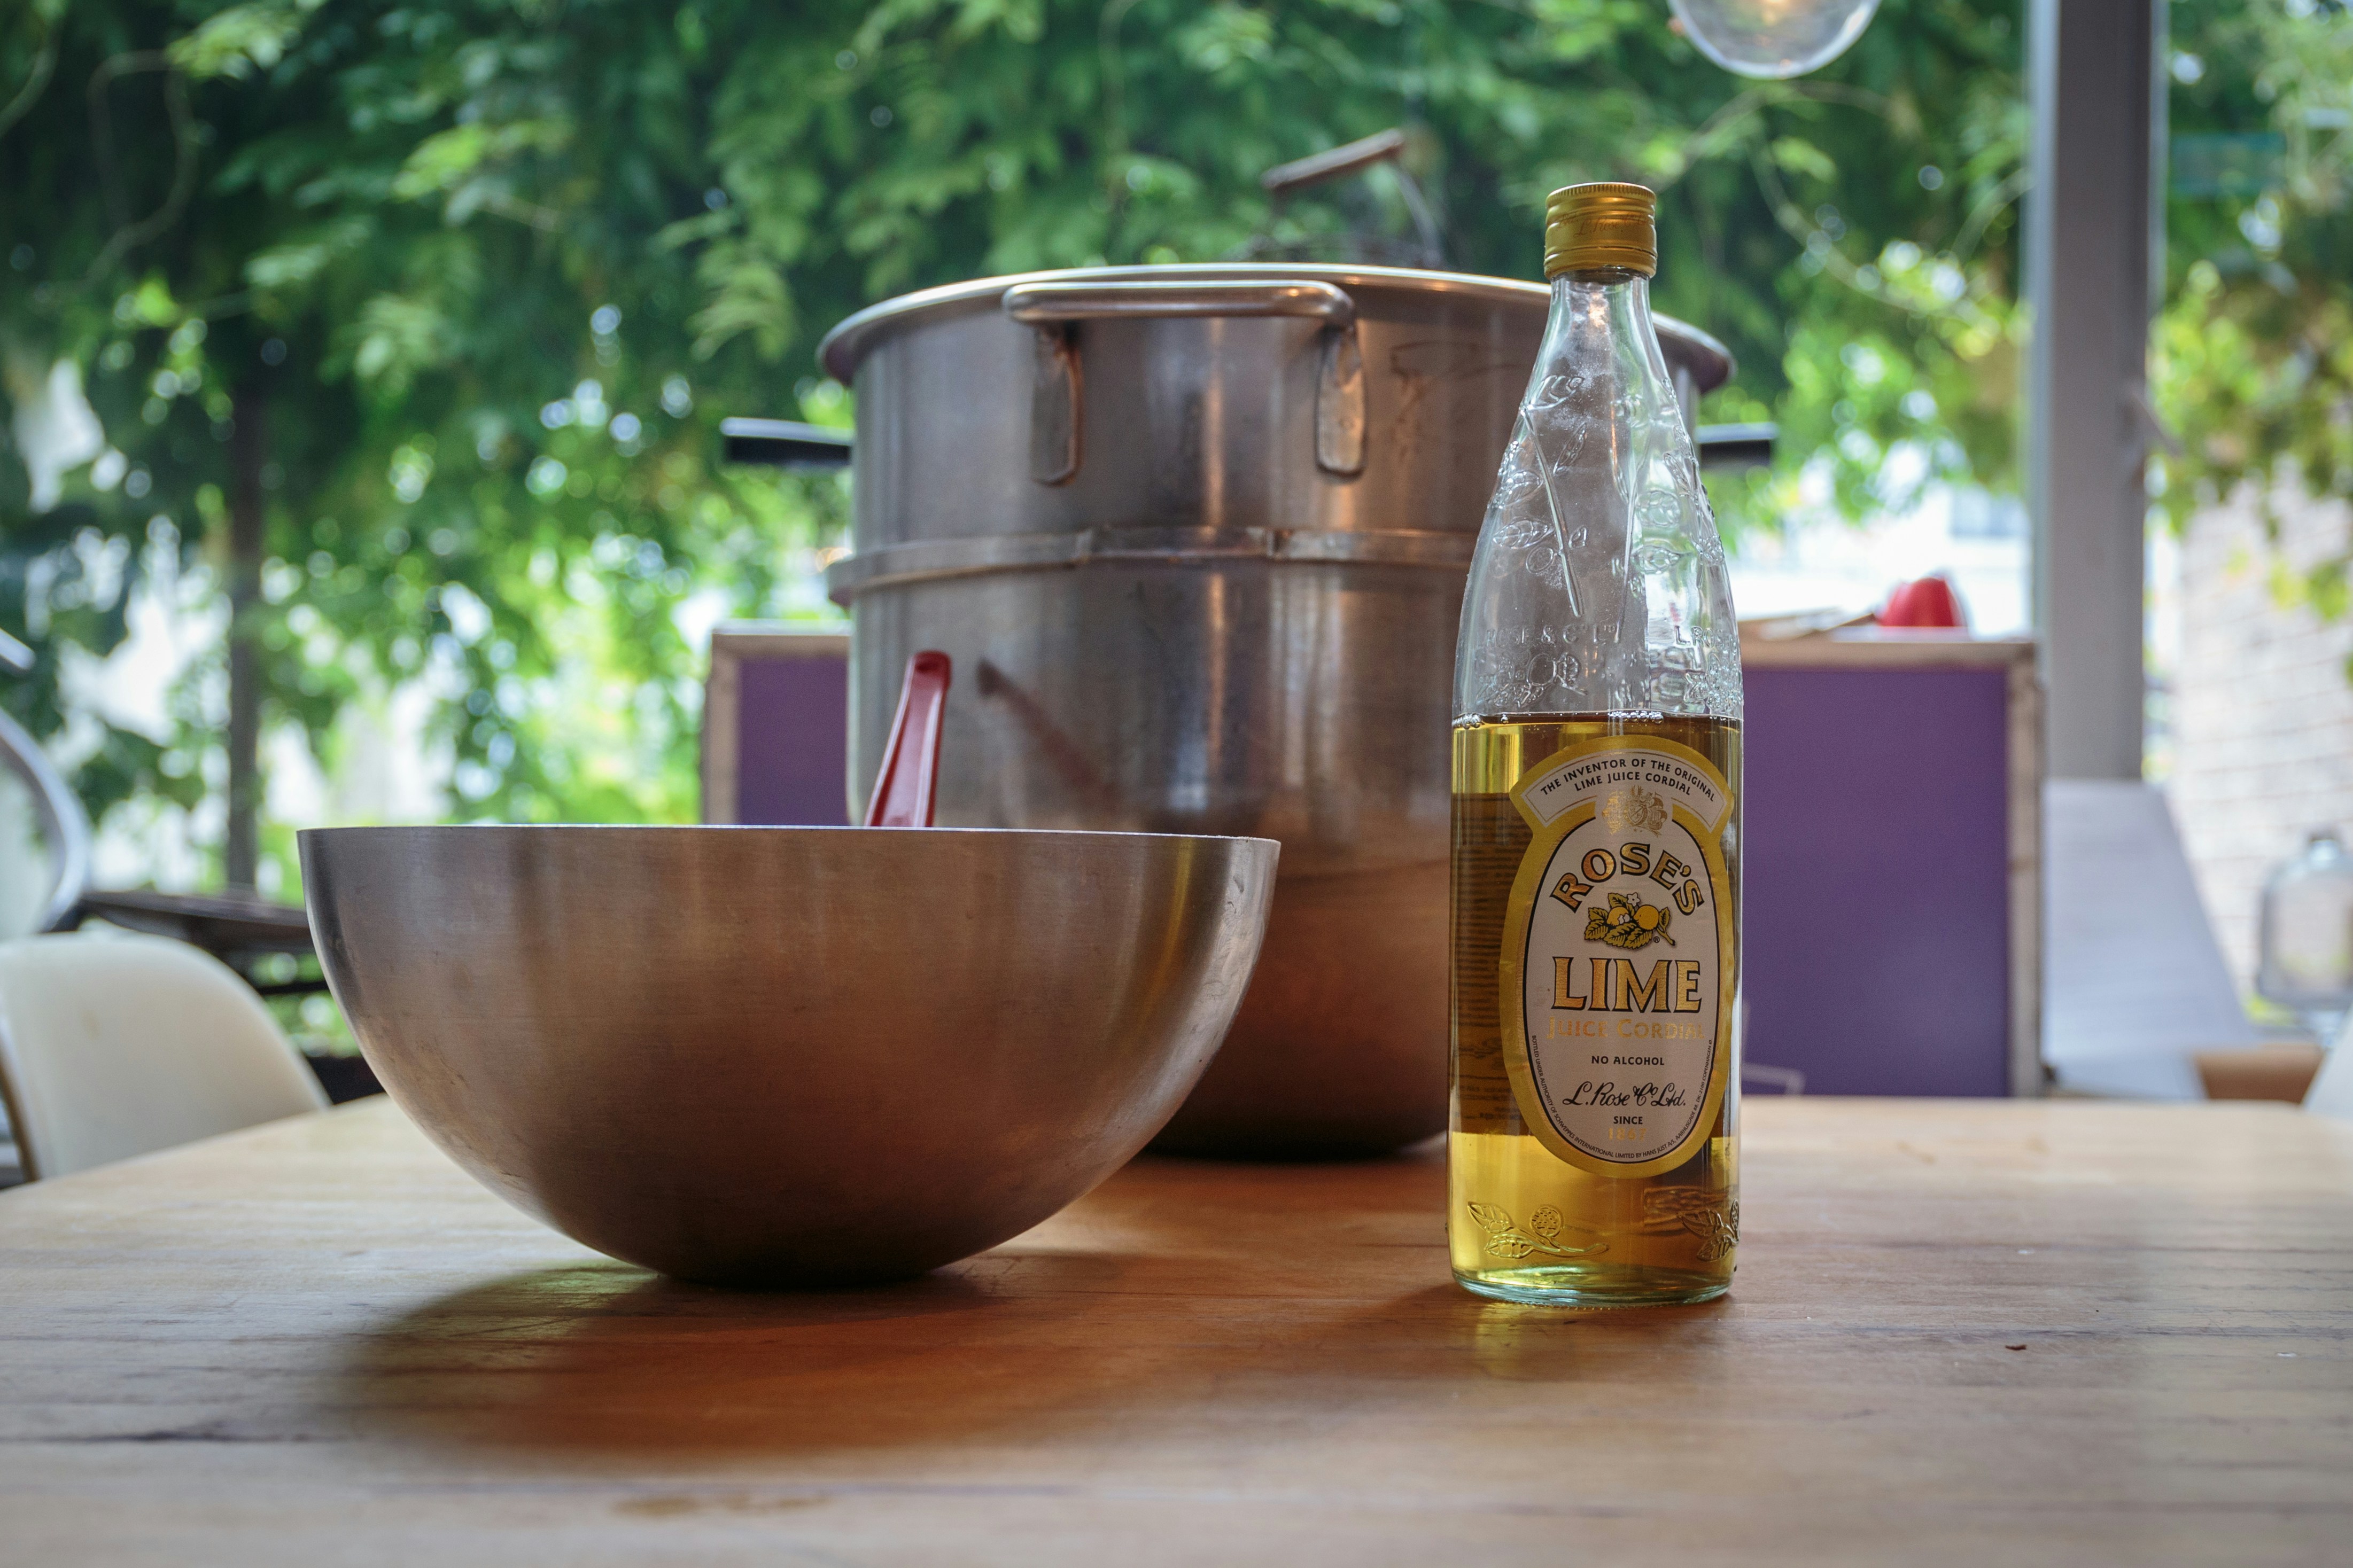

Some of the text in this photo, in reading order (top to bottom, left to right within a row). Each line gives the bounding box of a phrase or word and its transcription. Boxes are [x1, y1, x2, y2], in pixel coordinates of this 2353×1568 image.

[1540, 758, 1714, 802] THE INVENTOR OF THE ORIGINAL
[1574, 771, 1691, 795] LIME JUICE CORDIAL
[1550, 842, 1705, 916] ROSE'S
[1551, 956, 1703, 1013] LIME
[1591, 1056, 1665, 1066] NO ALCOHOL
[1535, 1059, 1543, 1077] UNDER
[1540, 1078, 1554, 1106] AUTHORITY
[1554, 1113, 1575, 1139] SCHWEPPES
[1574, 1136, 1614, 1157] INTERNATIONAL
[1642, 1149, 1657, 1157] HANS
[1657, 1144, 1667, 1154] JUST
[1675, 1111, 1696, 1141] AARHUSGADE
[1702, 1046, 1712, 1081] COPENHAGEN
[1613, 1115, 1643, 1125] SINCE
